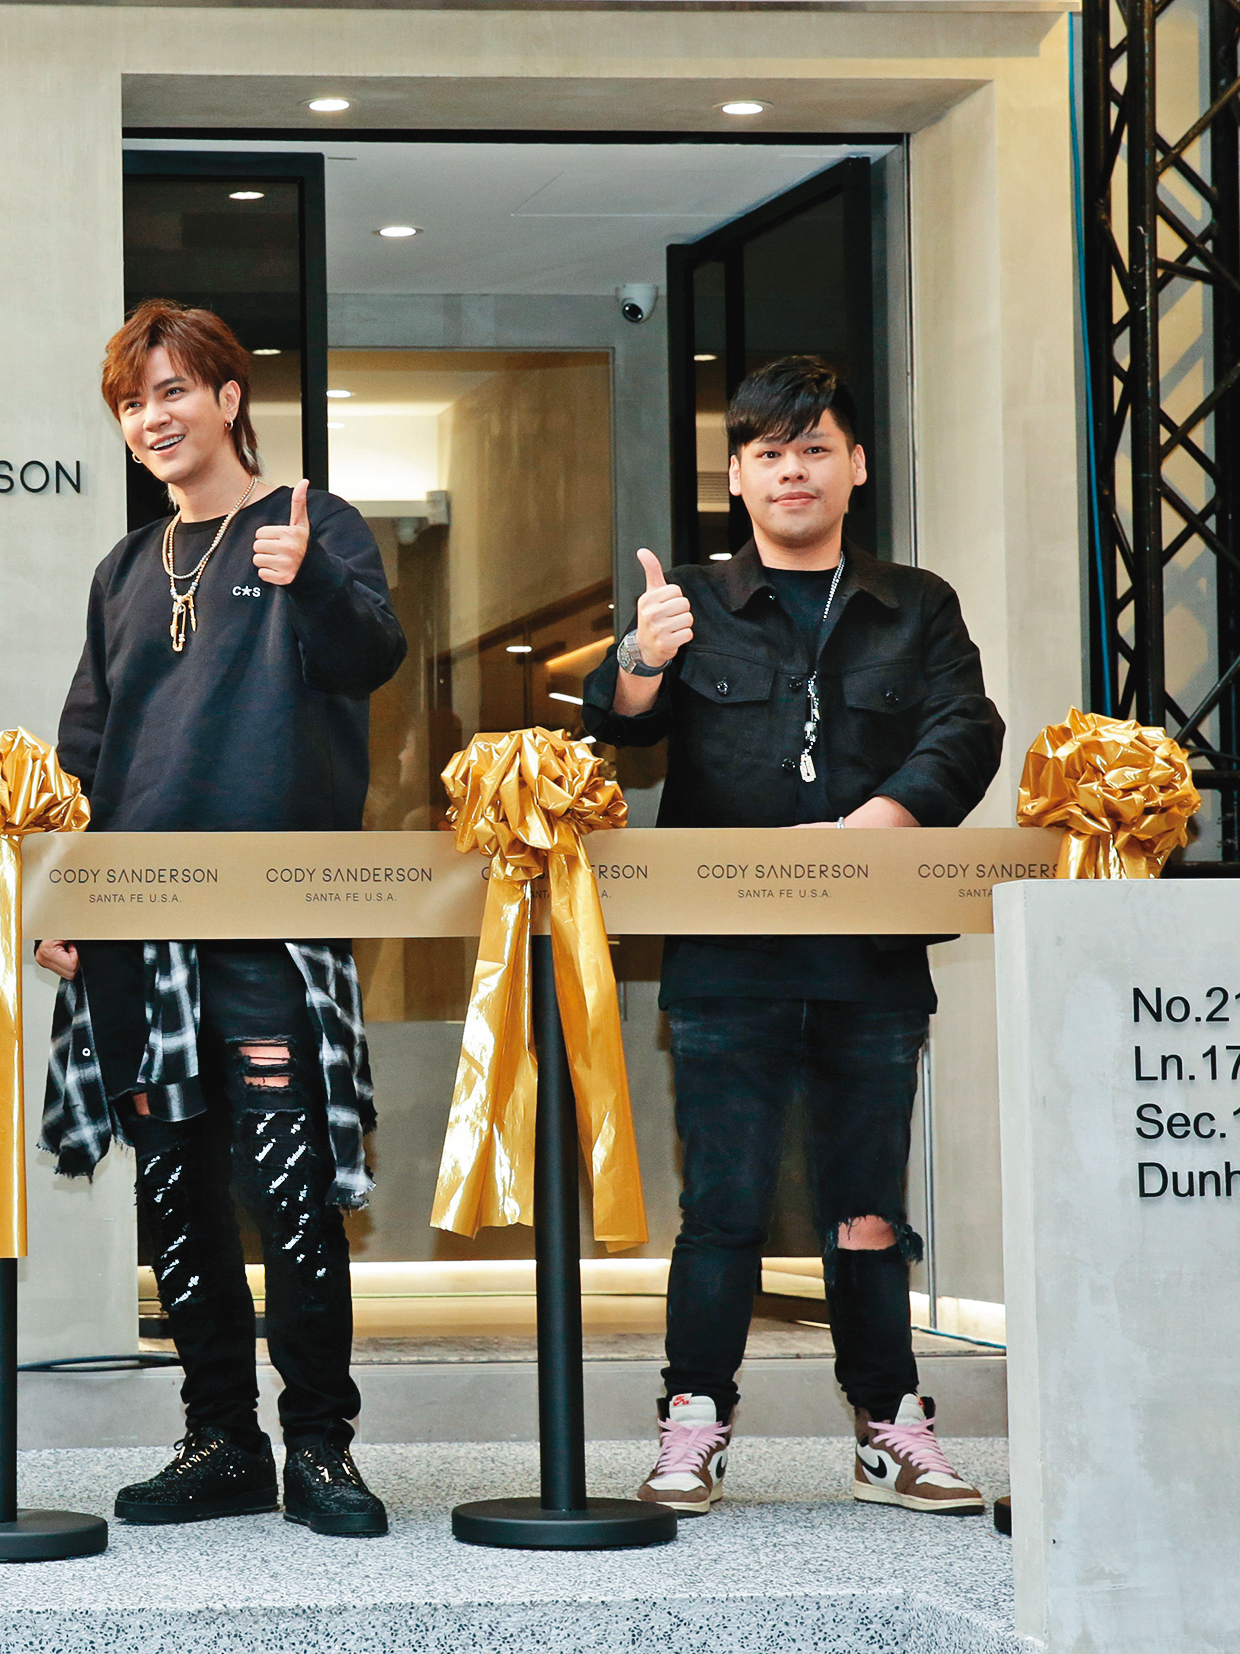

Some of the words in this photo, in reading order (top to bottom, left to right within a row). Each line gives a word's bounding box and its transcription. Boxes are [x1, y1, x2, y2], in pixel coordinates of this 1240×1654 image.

[49, 868, 101, 884] CODY
[106, 868, 218, 884] SANDERSON
[265, 867, 317, 883] CODY
[322, 867, 432, 883] SANDERSON
[591, 864, 648, 880] RSON
[696, 864, 749, 879] CODY
[754, 863, 869, 879] SANDERSON
[917, 863, 970, 879] CODY
[975, 863, 1058, 878] SANDERS
[88, 893, 126, 904] SANTA
[129, 893, 144, 903] FE
[149, 893, 182, 903] U.S.A.
[305, 892, 342, 903] SANTA
[345, 892, 360, 902] FE
[364, 892, 397, 902] U.S.A.
[737, 888, 775, 899] SANTA
[779, 888, 794, 899] FE
[798, 888, 832, 899] U.S.A.
[1132, 986, 1240, 1023] No.2
[1135, 1103, 1240, 1140] Sec.
